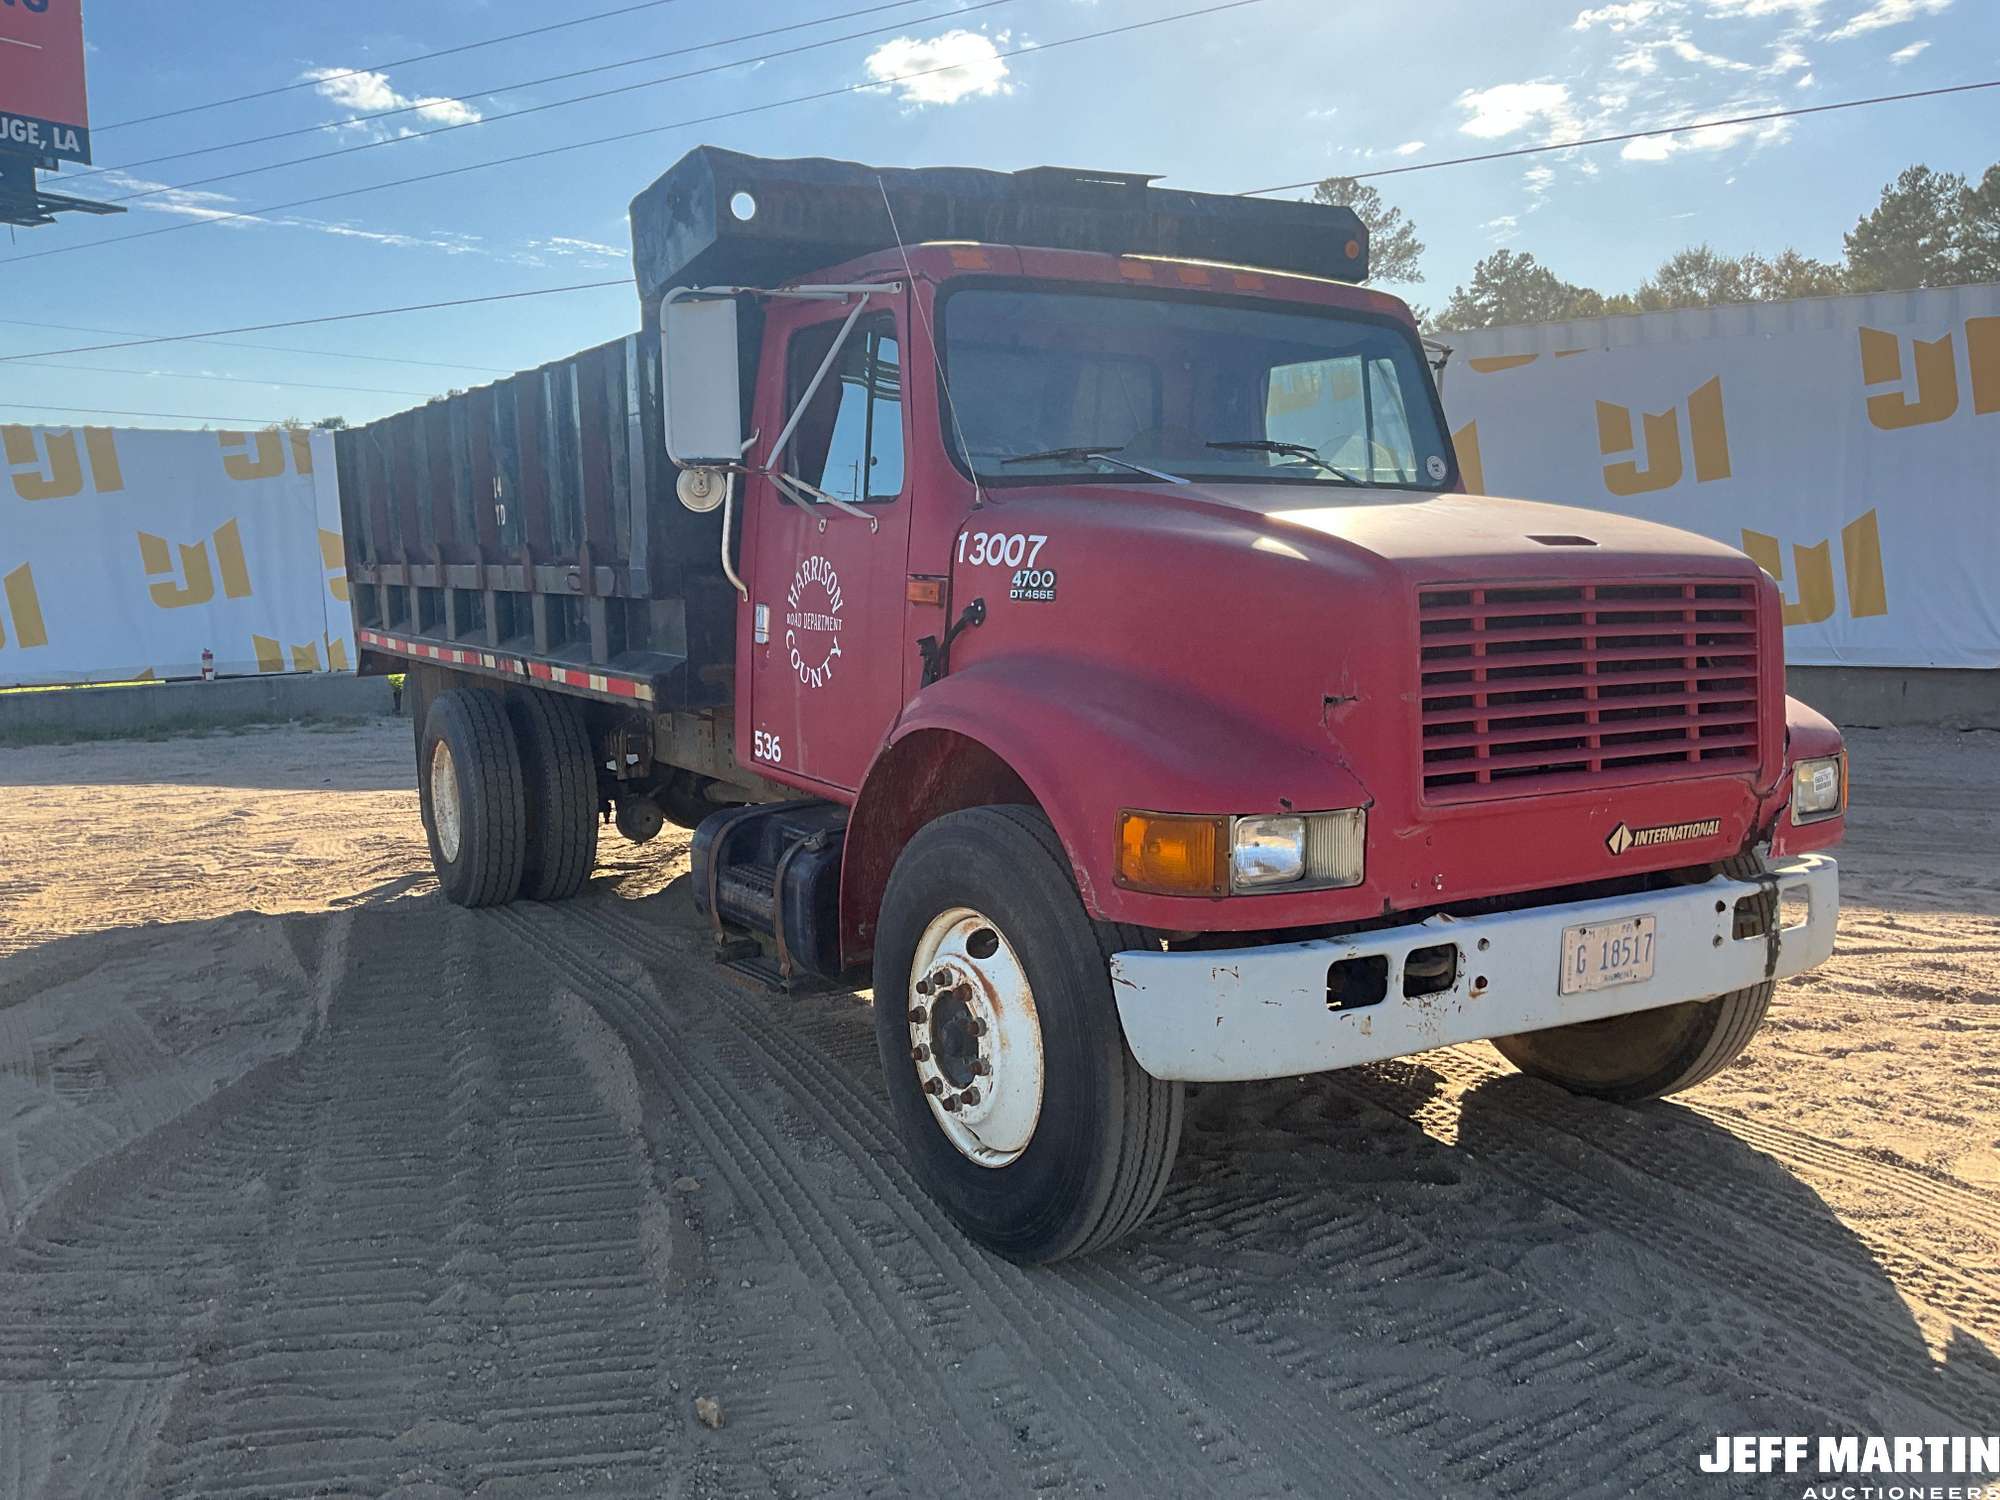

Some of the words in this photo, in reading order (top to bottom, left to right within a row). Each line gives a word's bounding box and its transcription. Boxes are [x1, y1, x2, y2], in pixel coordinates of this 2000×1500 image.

[53, 127, 81, 152] LA
[958, 531, 1048, 568] 13007
[787, 556, 844, 614] HARRISON
[1011, 570, 1055, 588] 4700
[786, 612, 802, 628] ROAD
[803, 612, 843, 631] DEPARTMENT
[785, 629, 842, 689] COUNTY
[754, 730, 782, 763] 536
[1633, 820, 1721, 847] INTERNATIONAL
[1576, 944, 1587, 975] G
[1600, 932, 1653, 971] 18517
